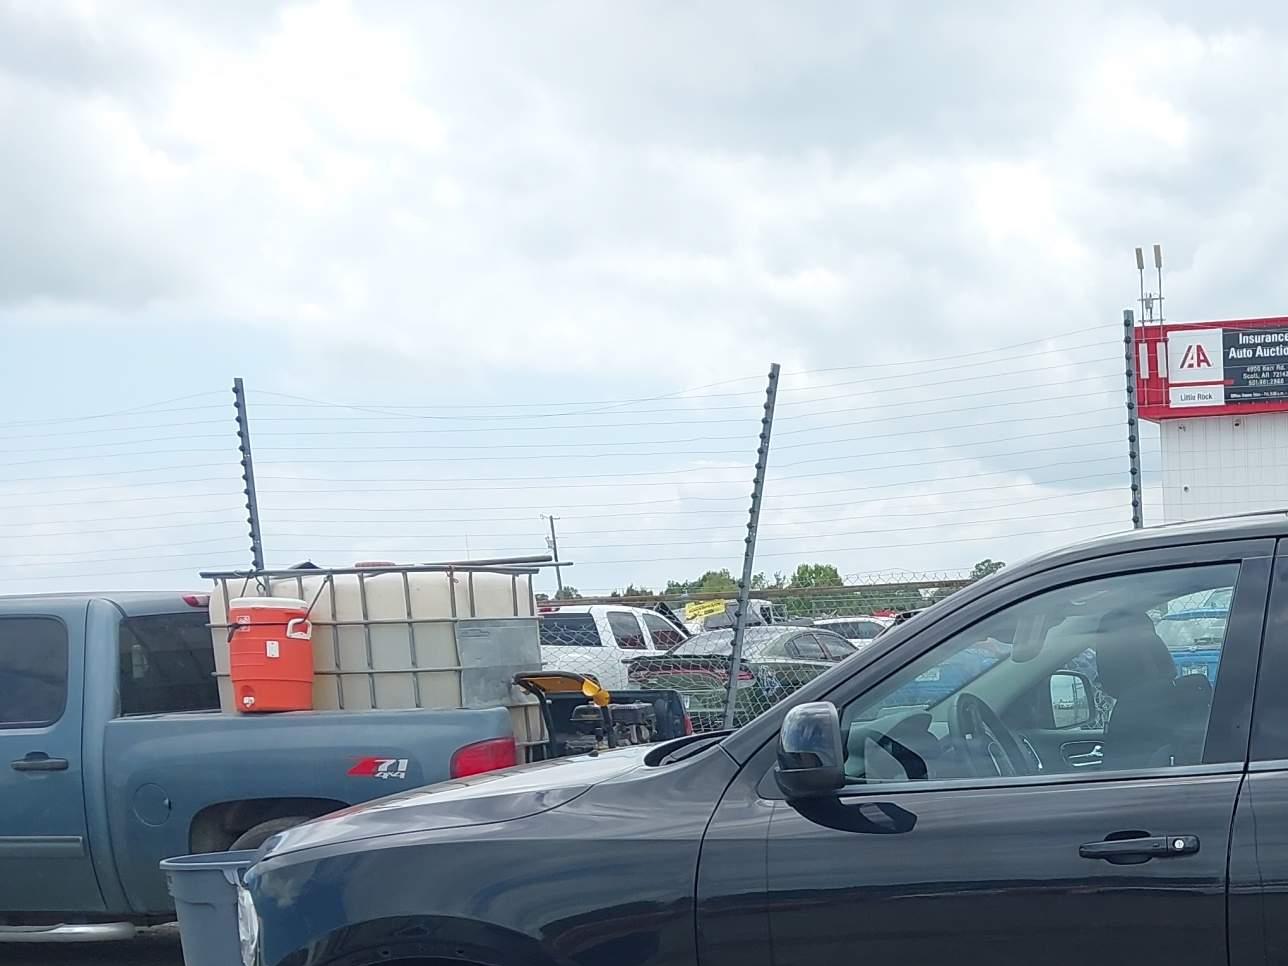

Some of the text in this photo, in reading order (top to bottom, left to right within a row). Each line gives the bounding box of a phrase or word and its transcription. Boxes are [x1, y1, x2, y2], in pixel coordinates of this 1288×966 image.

[1228, 347, 1253, 359] Auto
[1180, 391, 1213, 401] Little Rock
